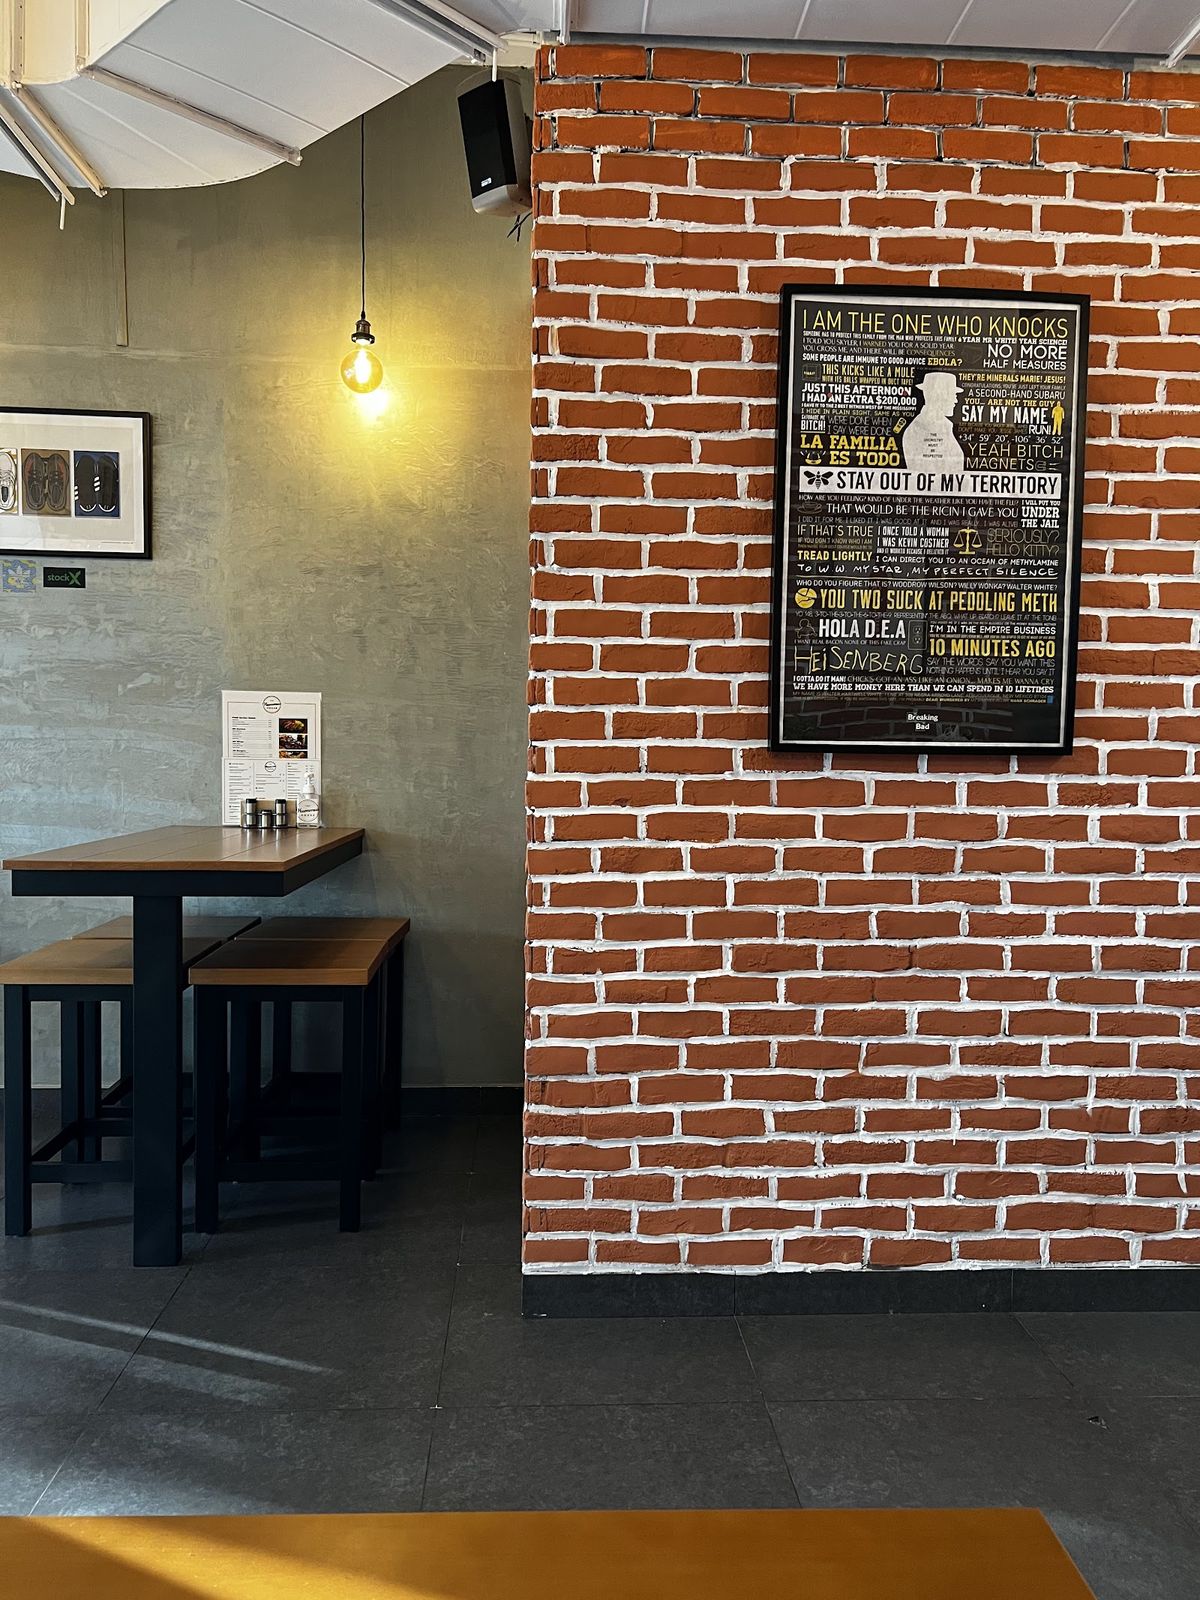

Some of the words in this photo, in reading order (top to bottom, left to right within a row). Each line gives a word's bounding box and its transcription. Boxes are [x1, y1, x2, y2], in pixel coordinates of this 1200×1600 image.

[804, 309, 807, 329] I
[813, 310, 841, 331] AM
[848, 312, 886, 333] THE
[892, 313, 932, 334] ONE
[938, 315, 982, 336] WHO
[989, 316, 1068, 338] KNOCKS
[988, 345, 1012, 358] NO
[1020, 346, 1067, 360] MORE
[802, 353, 818, 361] SOME
[820, 354, 842, 362] PEOPLE
[843, 354, 854, 363] ARE
[856, 355, 879, 364] IMMUNE
[880, 356, 888, 364] TO
[888, 356, 904, 365] GOOD
[905, 357, 926, 366] ADVICE
[928, 358, 962, 367] EBOLA?
[983, 360, 1009, 369] HALF
[1013, 360, 1066, 370] MEASURES
[822, 364, 839, 375] THIS
[842, 364, 864, 376] KICKS
[867, 365, 884, 377] LIKE
[887, 366, 892, 377] A
[895, 366, 915, 378] MULE
[959, 373, 985, 381] THEY'RE
[987, 374, 1019, 382] MINERALS
[1020, 375, 1043, 383] MARIE!
[1044, 376, 1066, 384] JESUS!
[802, 382, 827, 393] JUST
[829, 384, 851, 394] THIS
[852, 386, 912, 396] AFTERNOON
[968, 389, 975, 397] A
[976, 389, 1032, 399] SECOND-HAND
[1034, 390, 1066, 400] SUBARU
[802, 393, 805, 402] I
[807, 393, 827, 403] HAD
[830, 394, 842, 403] AN
[843, 395, 874, 404] EXTRA
[876, 395, 917, 406] $200,000
[962, 405, 985, 422] SAY
[990, 406, 1008, 423] MY
[1014, 407, 1048, 424] NAME
[800, 420, 826, 431] BITCH!
[800, 434, 824, 449] LA
[830, 435, 898, 451] FAMILIA
[968, 443, 1010, 457] YEAH
[1017, 444, 1064, 459] BITCH
[829, 451, 850, 465] ES
[856, 452, 900, 467] TODO
[966, 457, 1034, 471] MAGNETS
[837, 471, 875, 490] STAY
[880, 472, 912, 491] OUT
[917, 473, 936, 491] OF
[941, 474, 965, 492] MY
[970, 475, 1058, 495] TERRITORY
[826, 503, 852, 514] THAT
[854, 504, 894, 515] WOULD
[896, 505, 908, 515] BE
[910, 505, 929, 516] THE
[932, 506, 960, 517] RICIN
[963, 507, 965, 516] I
[968, 507, 994, 517] GAVE
[997, 508, 1019, 518] YOU
[1022, 506, 1060, 518] UNDER
[1021, 519, 1038, 528] THE
[1040, 520, 1060, 528] JAIL
[798, 525, 807, 536] IF
[810, 525, 844, 536] THAT'S
[847, 526, 873, 537] TRUE
[882, 526, 899, 536] ONCE
[902, 527, 918, 536] TOLD
[920, 527, 924, 536] A
[926, 527, 949, 537] WOMAN
[987, 528, 1060, 544] SERIOUSLY?
[882, 538, 897, 547] WAS
[900, 538, 918, 548] KEVIN
[920, 538, 949, 548] COSTNER
[986, 543, 1020, 556] HELLO
[1023, 544, 1060, 557] KITTY?
[798, 550, 830, 560] TREAD
[832, 551, 873, 561] LIGHTLY
[853, 565, 870, 573] MY
[934, 568, 989, 576] PERFECT
[996, 568, 1058, 576] SILENCE
[47, 570, 81, 586] stockX
[820, 588, 846, 609] YOU
[852, 589, 881, 610] TWO
[887, 590, 923, 610] SUCK
[929, 591, 944, 611] AT
[950, 591, 1015, 612] PEDDLING
[1022, 592, 1058, 613] METH
[819, 618, 860, 638] HOLA
[865, 620, 906, 639] D.E.A
[930, 625, 944, 633] I'M
[947, 625, 957, 633] IN
[960, 625, 976, 634] THE
[980, 626, 1010, 634] EMPIRE
[1014, 626, 1056, 635] BUSINESS
[930, 639, 946, 656] 10
[951, 639, 1020, 657] MINUTES
[1025, 640, 1056, 658] AGO
[994, 685, 1004, 693] IN
[908, 714, 939, 722] Breaking
